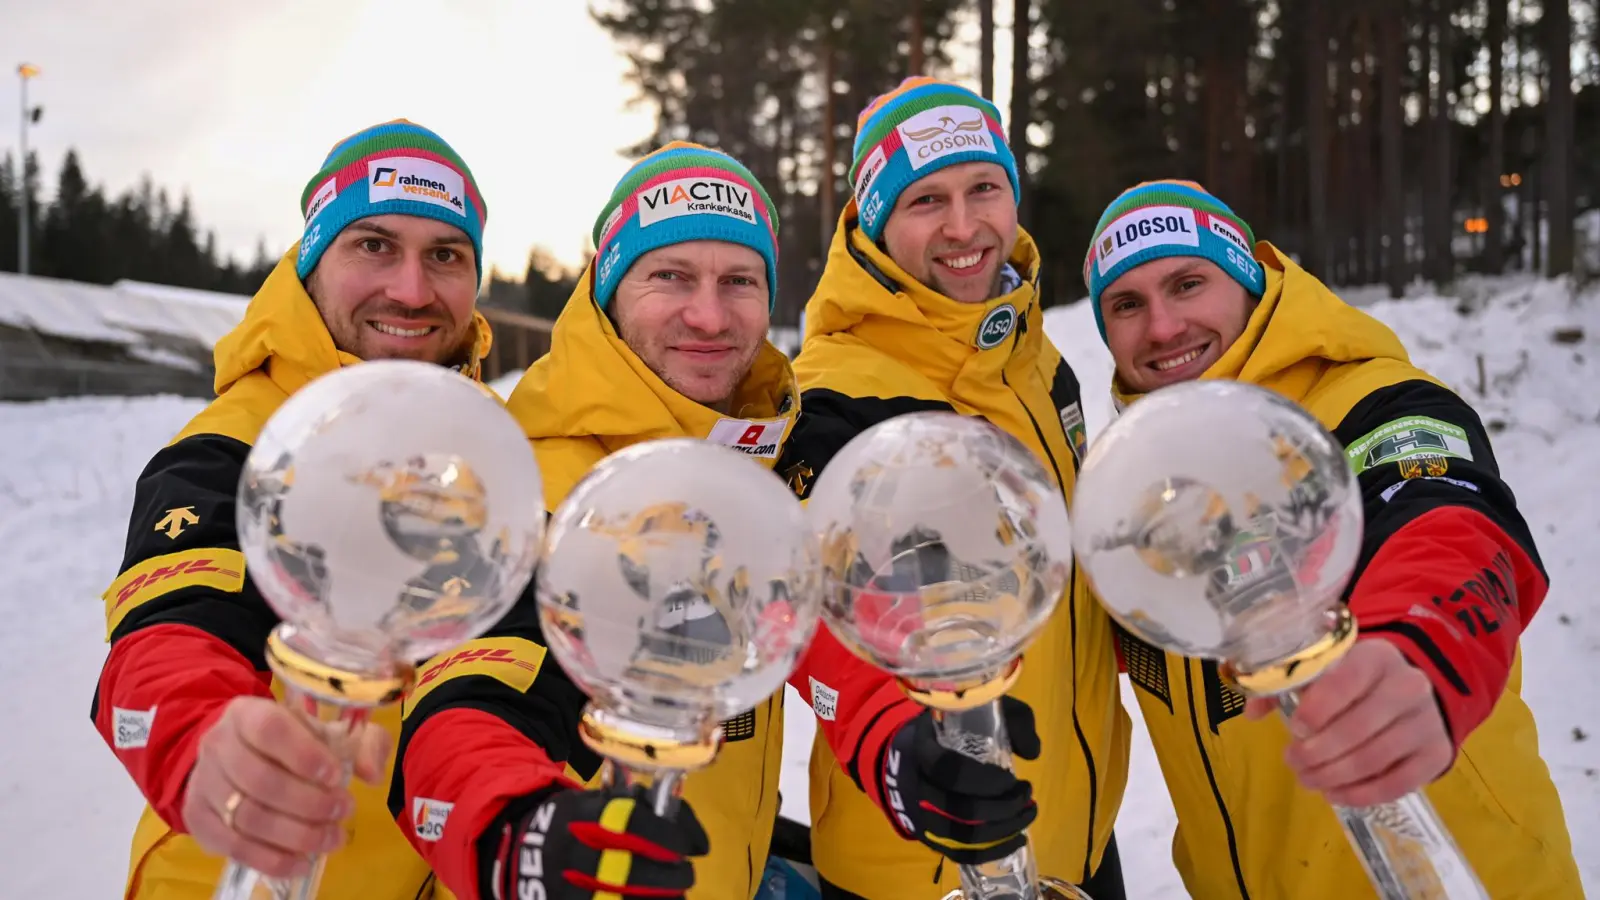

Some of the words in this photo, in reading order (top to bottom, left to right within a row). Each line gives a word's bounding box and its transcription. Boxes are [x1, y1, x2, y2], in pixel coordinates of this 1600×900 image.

[917, 134, 989, 159] COSONA
[399, 174, 446, 192] rahmen
[402, 184, 463, 210] versand.de
[643, 182, 748, 210] VIACTIV
[687, 202, 752, 221] Krankenkasse
[863, 190, 884, 227] SEIZ
[300, 223, 321, 262] SEIZ
[1115, 216, 1192, 248] LOGSOL
[600, 242, 621, 286] SEIZ
[1226, 247, 1257, 283] SEIZ
[984, 318, 1010, 336] ASQ
[115, 559, 221, 610] DHL
[416, 648, 517, 689] DHL
[517, 801, 557, 900] SEIZ
